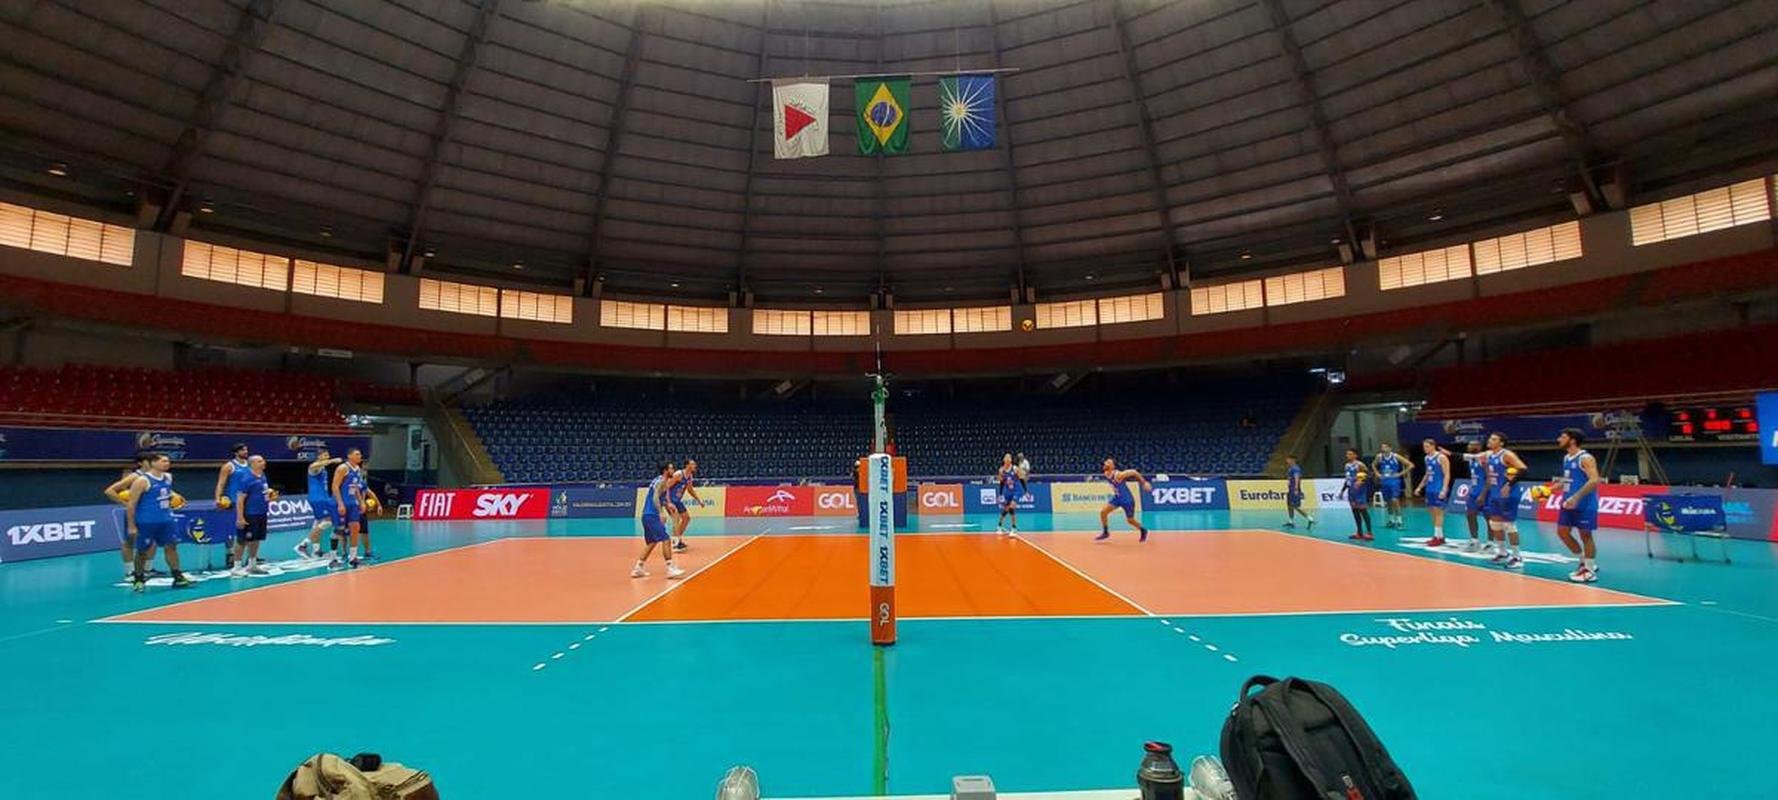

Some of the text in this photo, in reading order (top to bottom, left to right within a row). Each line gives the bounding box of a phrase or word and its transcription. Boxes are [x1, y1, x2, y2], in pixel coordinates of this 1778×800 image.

[419, 493, 455, 516] FIAT
[473, 493, 530, 516] SKY
[818, 493, 854, 508] GOL
[923, 492, 959, 507] GOL
[1152, 487, 1216, 504] 1XBET
[1240, 490, 1304, 500] Eurofar
[880, 501, 888, 538] 1XBET
[7, 520, 96, 545] 1XBET
[880, 546, 889, 585] 1XBET
[880, 602, 890, 627] GOL
[1374, 617, 1486, 632] Finais
[1340, 632, 1480, 649] Superliga
